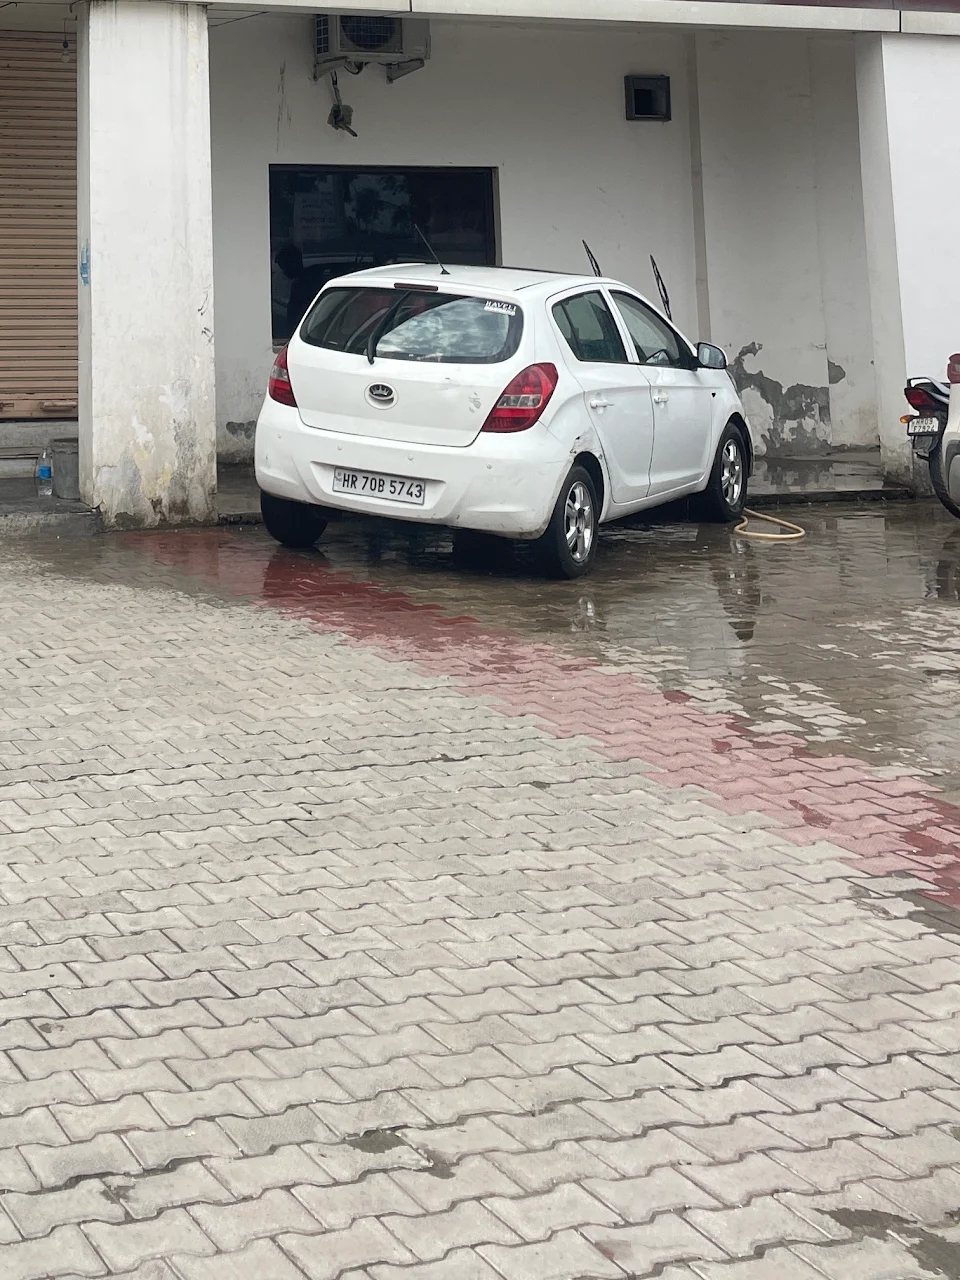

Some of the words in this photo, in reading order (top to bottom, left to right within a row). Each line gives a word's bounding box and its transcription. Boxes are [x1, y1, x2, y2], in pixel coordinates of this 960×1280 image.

[342, 473, 358, 489] HR
[361, 476, 385, 493] 70B
[389, 480, 423, 499] 5743
